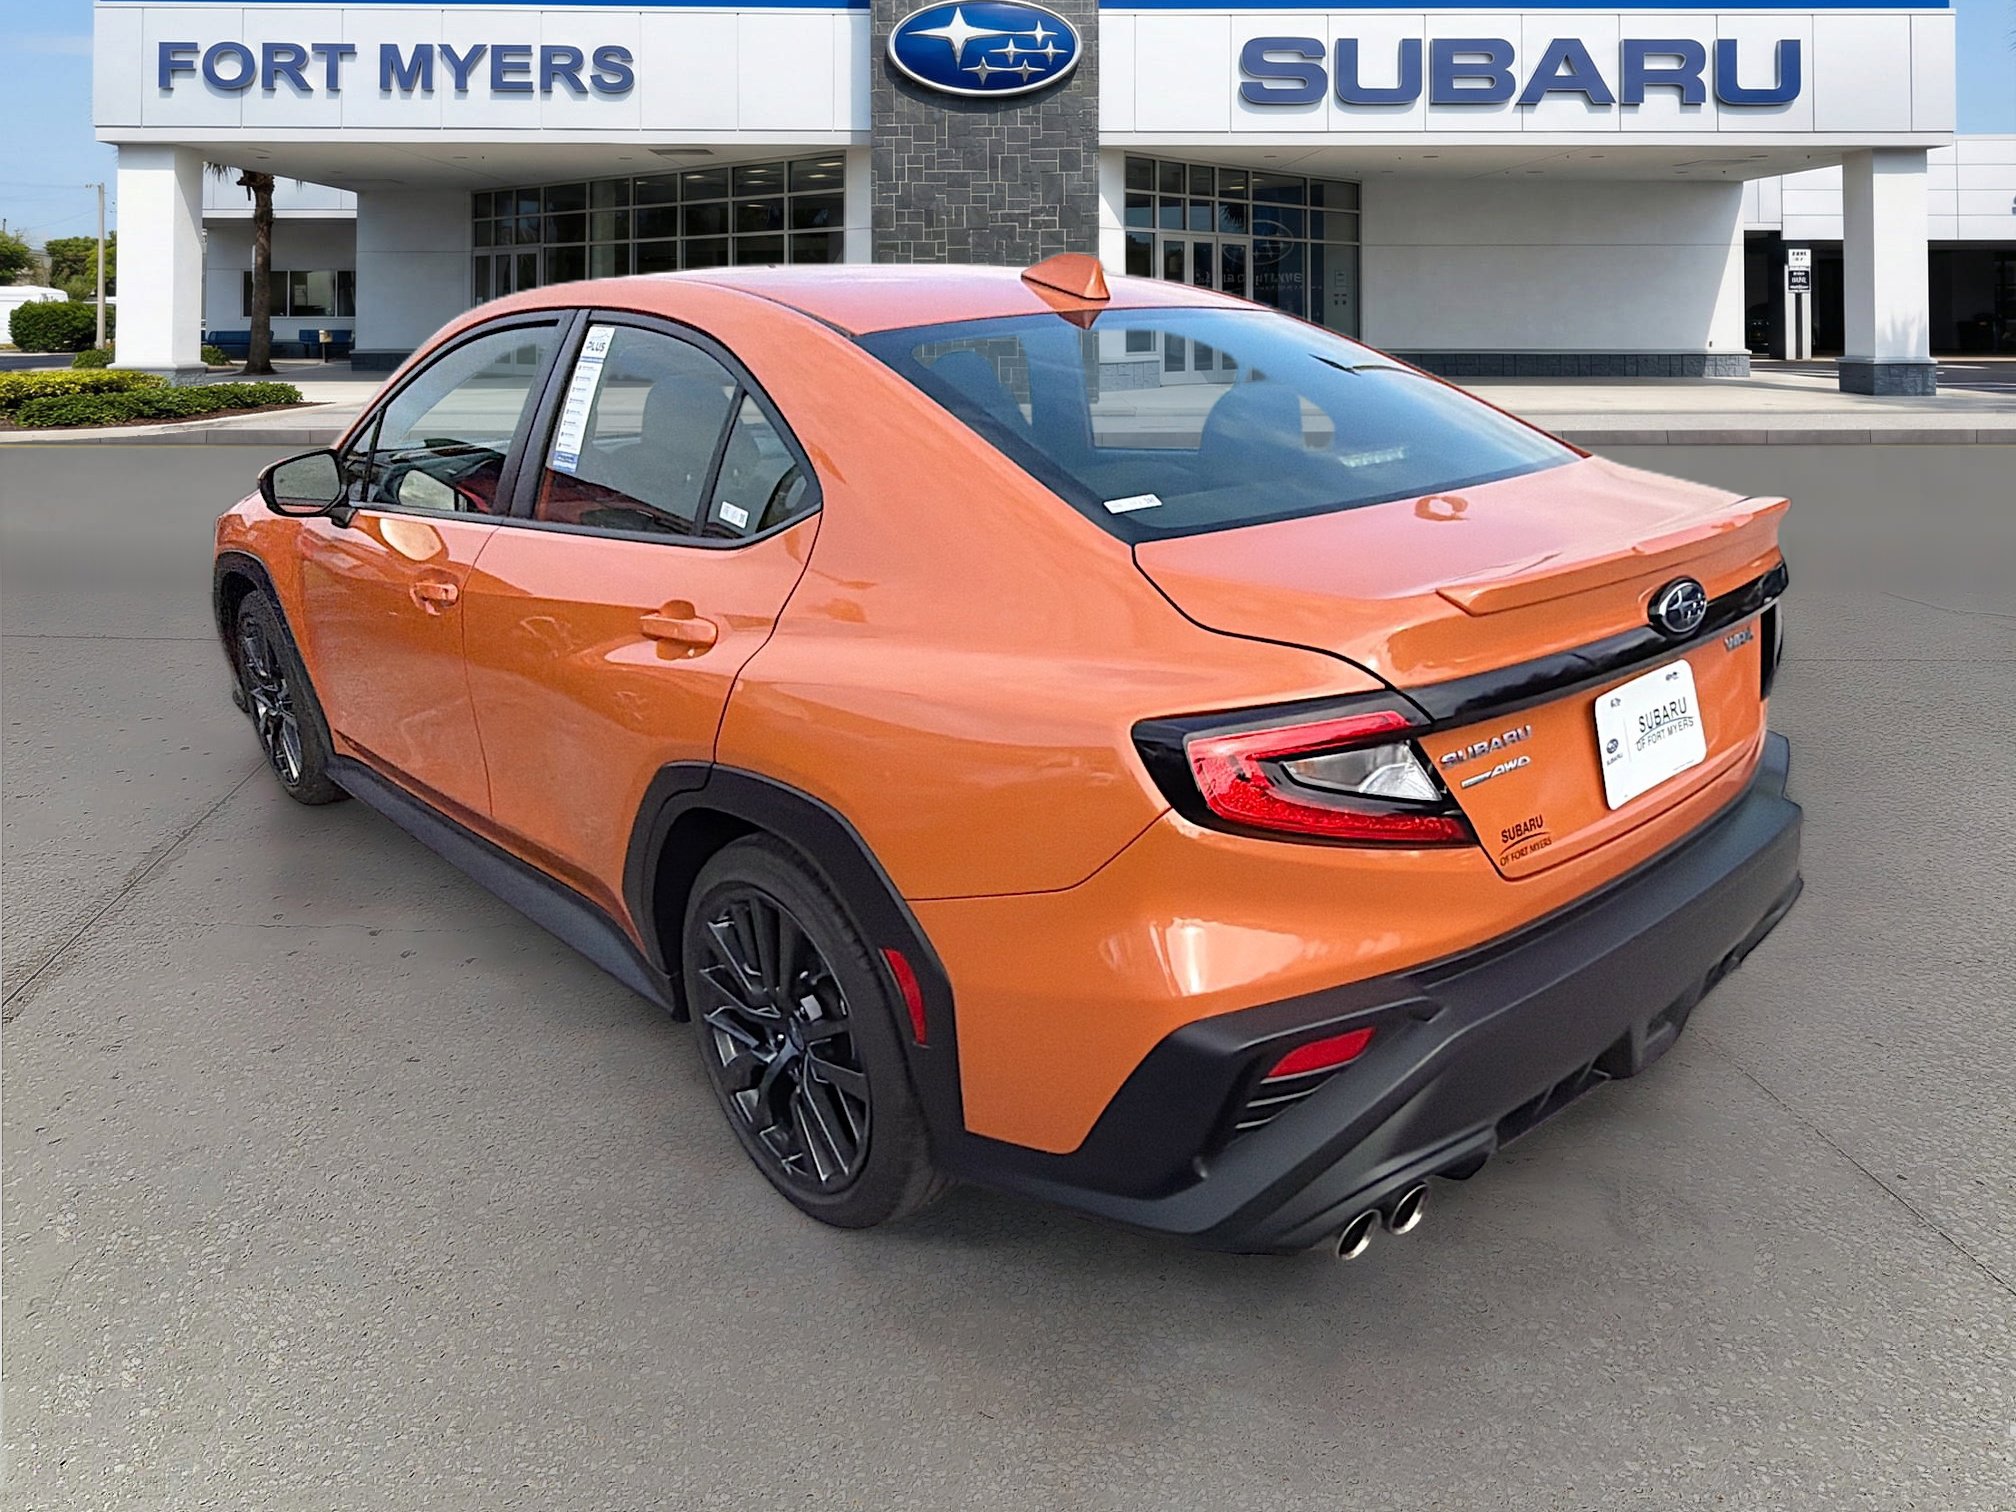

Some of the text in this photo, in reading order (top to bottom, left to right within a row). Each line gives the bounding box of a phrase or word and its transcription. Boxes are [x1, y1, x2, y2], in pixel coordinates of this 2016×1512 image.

[158, 41, 636, 94] FORT MYERS
[1238, 37, 1802, 106] SUBARU
[1638, 697, 1688, 733] SUBARU
[1440, 724, 1532, 769] SUBARU
[1636, 718, 1694, 752] OF FORT MYERS
[1490, 755, 1531, 778] AWD
[1501, 814, 1544, 844] SUBARU
[1500, 836, 1553, 867] OF FORT MYERS
